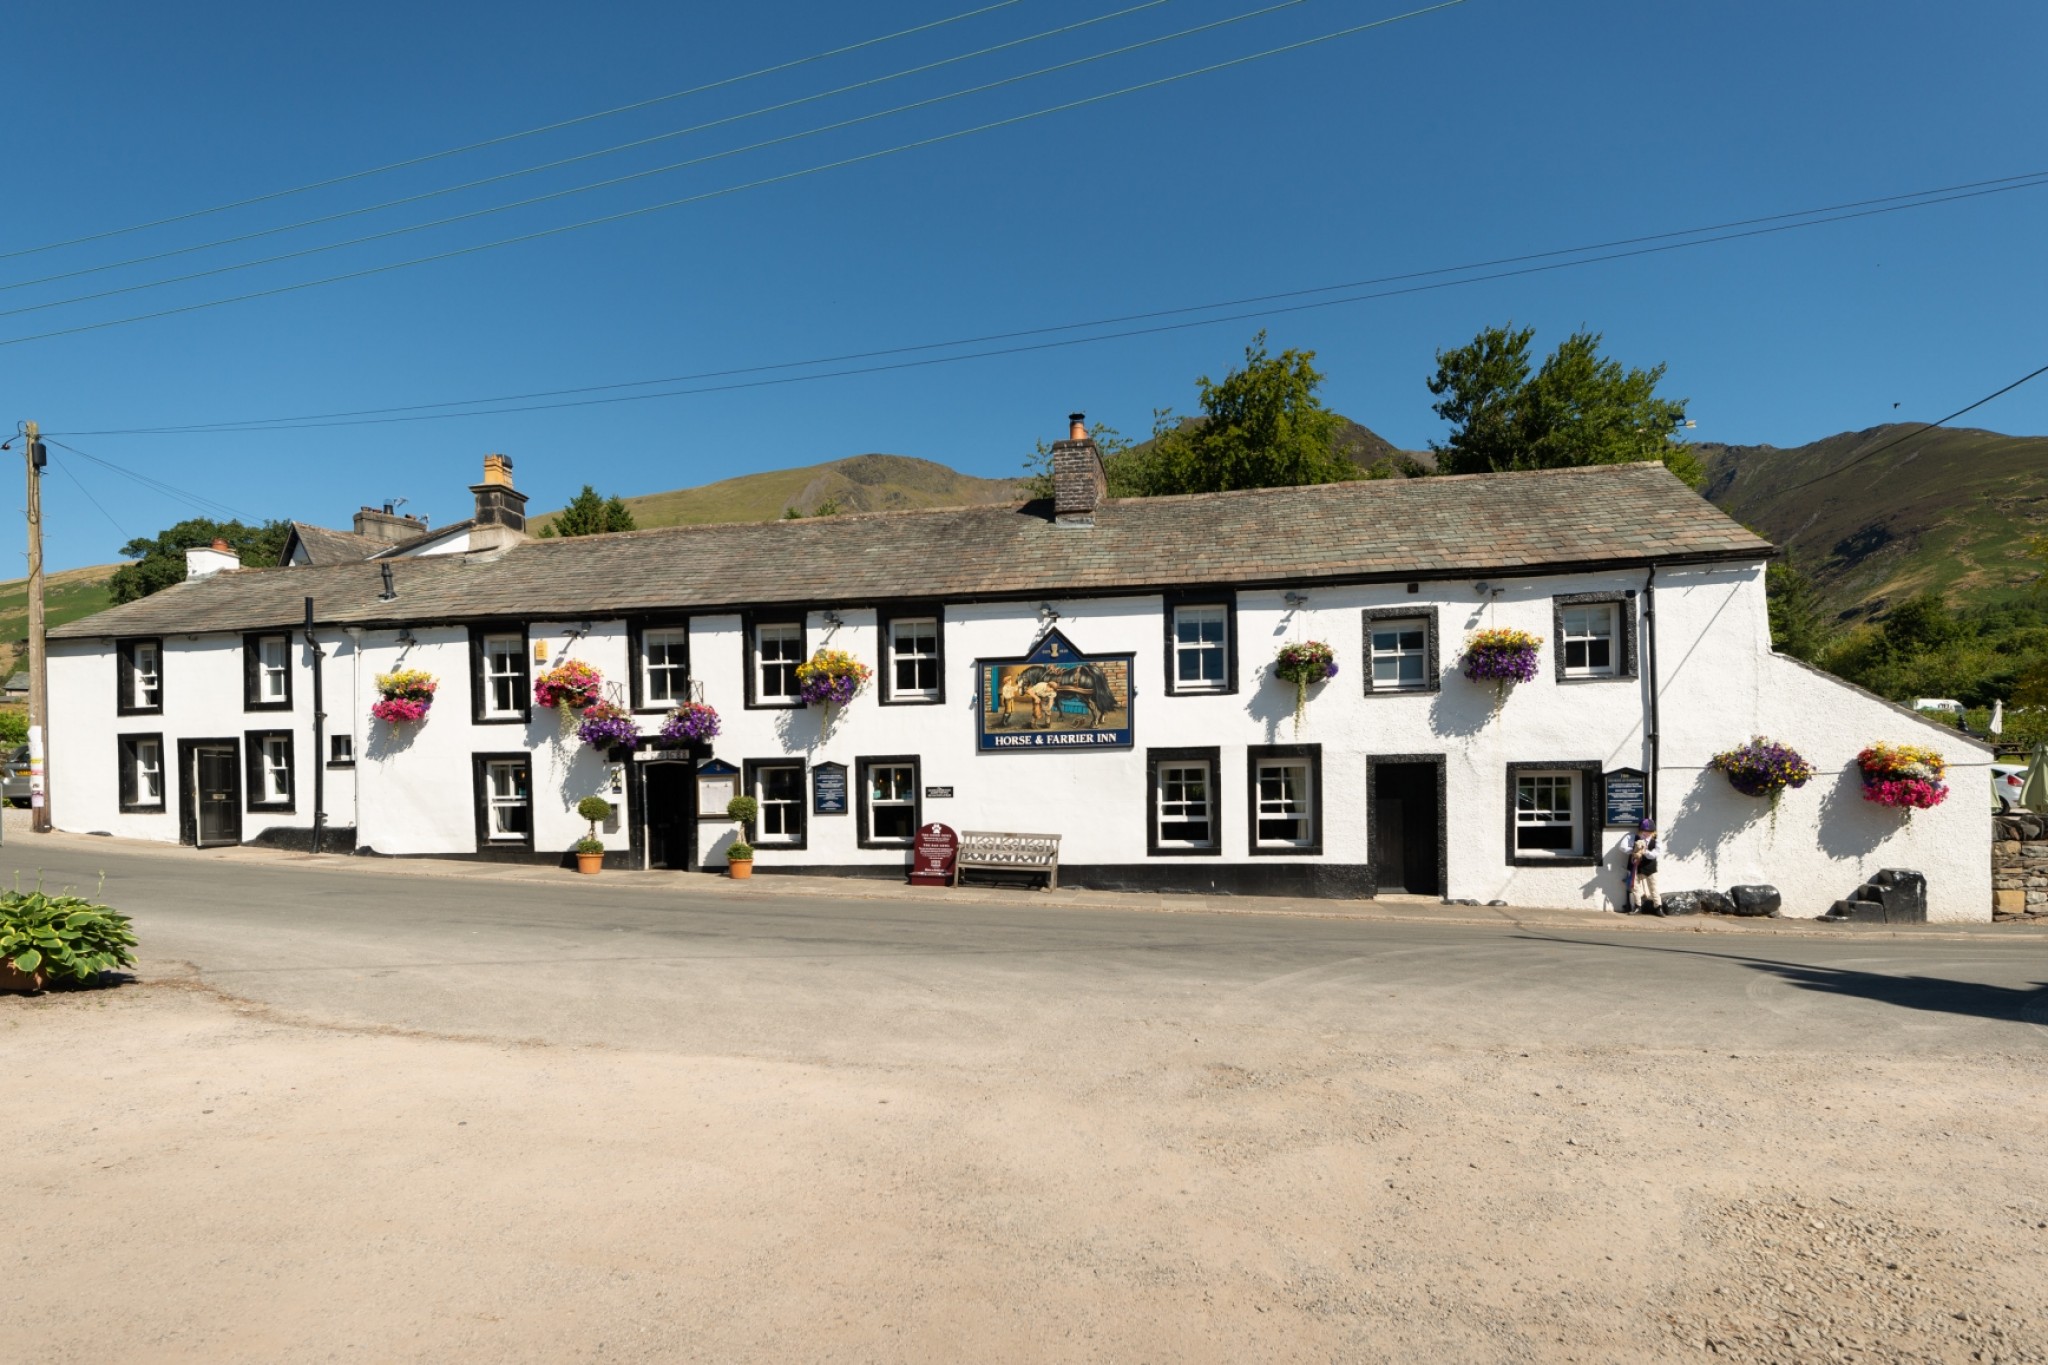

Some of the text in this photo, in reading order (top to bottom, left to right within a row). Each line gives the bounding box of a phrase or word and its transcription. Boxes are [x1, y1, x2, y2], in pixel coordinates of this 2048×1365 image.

[995, 733, 1117, 746] HORSE & FARRIER INN
